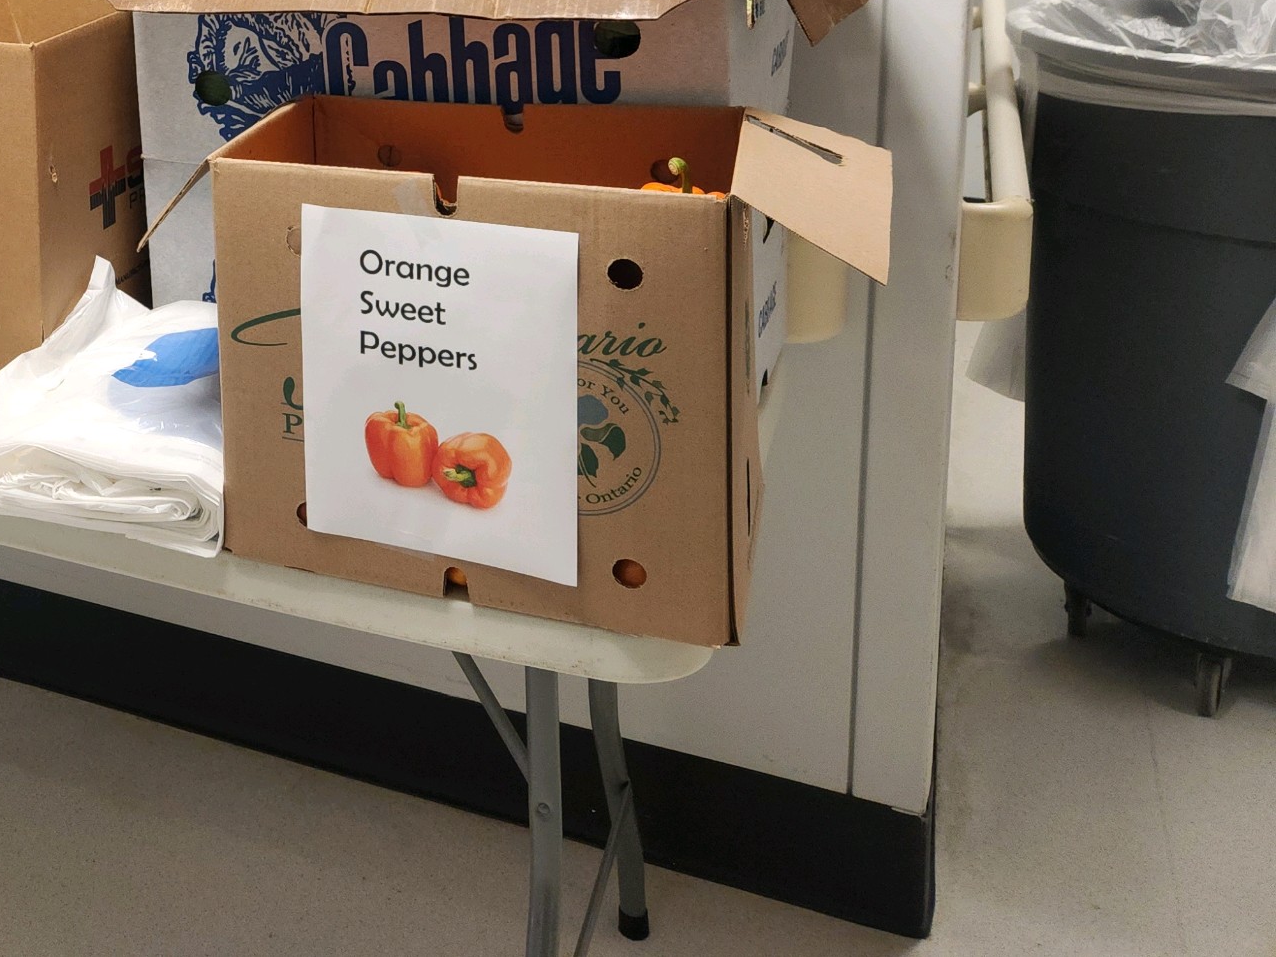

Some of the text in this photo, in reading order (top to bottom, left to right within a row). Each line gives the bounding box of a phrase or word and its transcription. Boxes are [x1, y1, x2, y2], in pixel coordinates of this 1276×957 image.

[359, 248, 471, 288] Orange
[359, 290, 447, 326] Sweet
[359, 330, 478, 371] Peppers
[602, 384, 630, 415] You
[586, 466, 642, 505] Ontario
